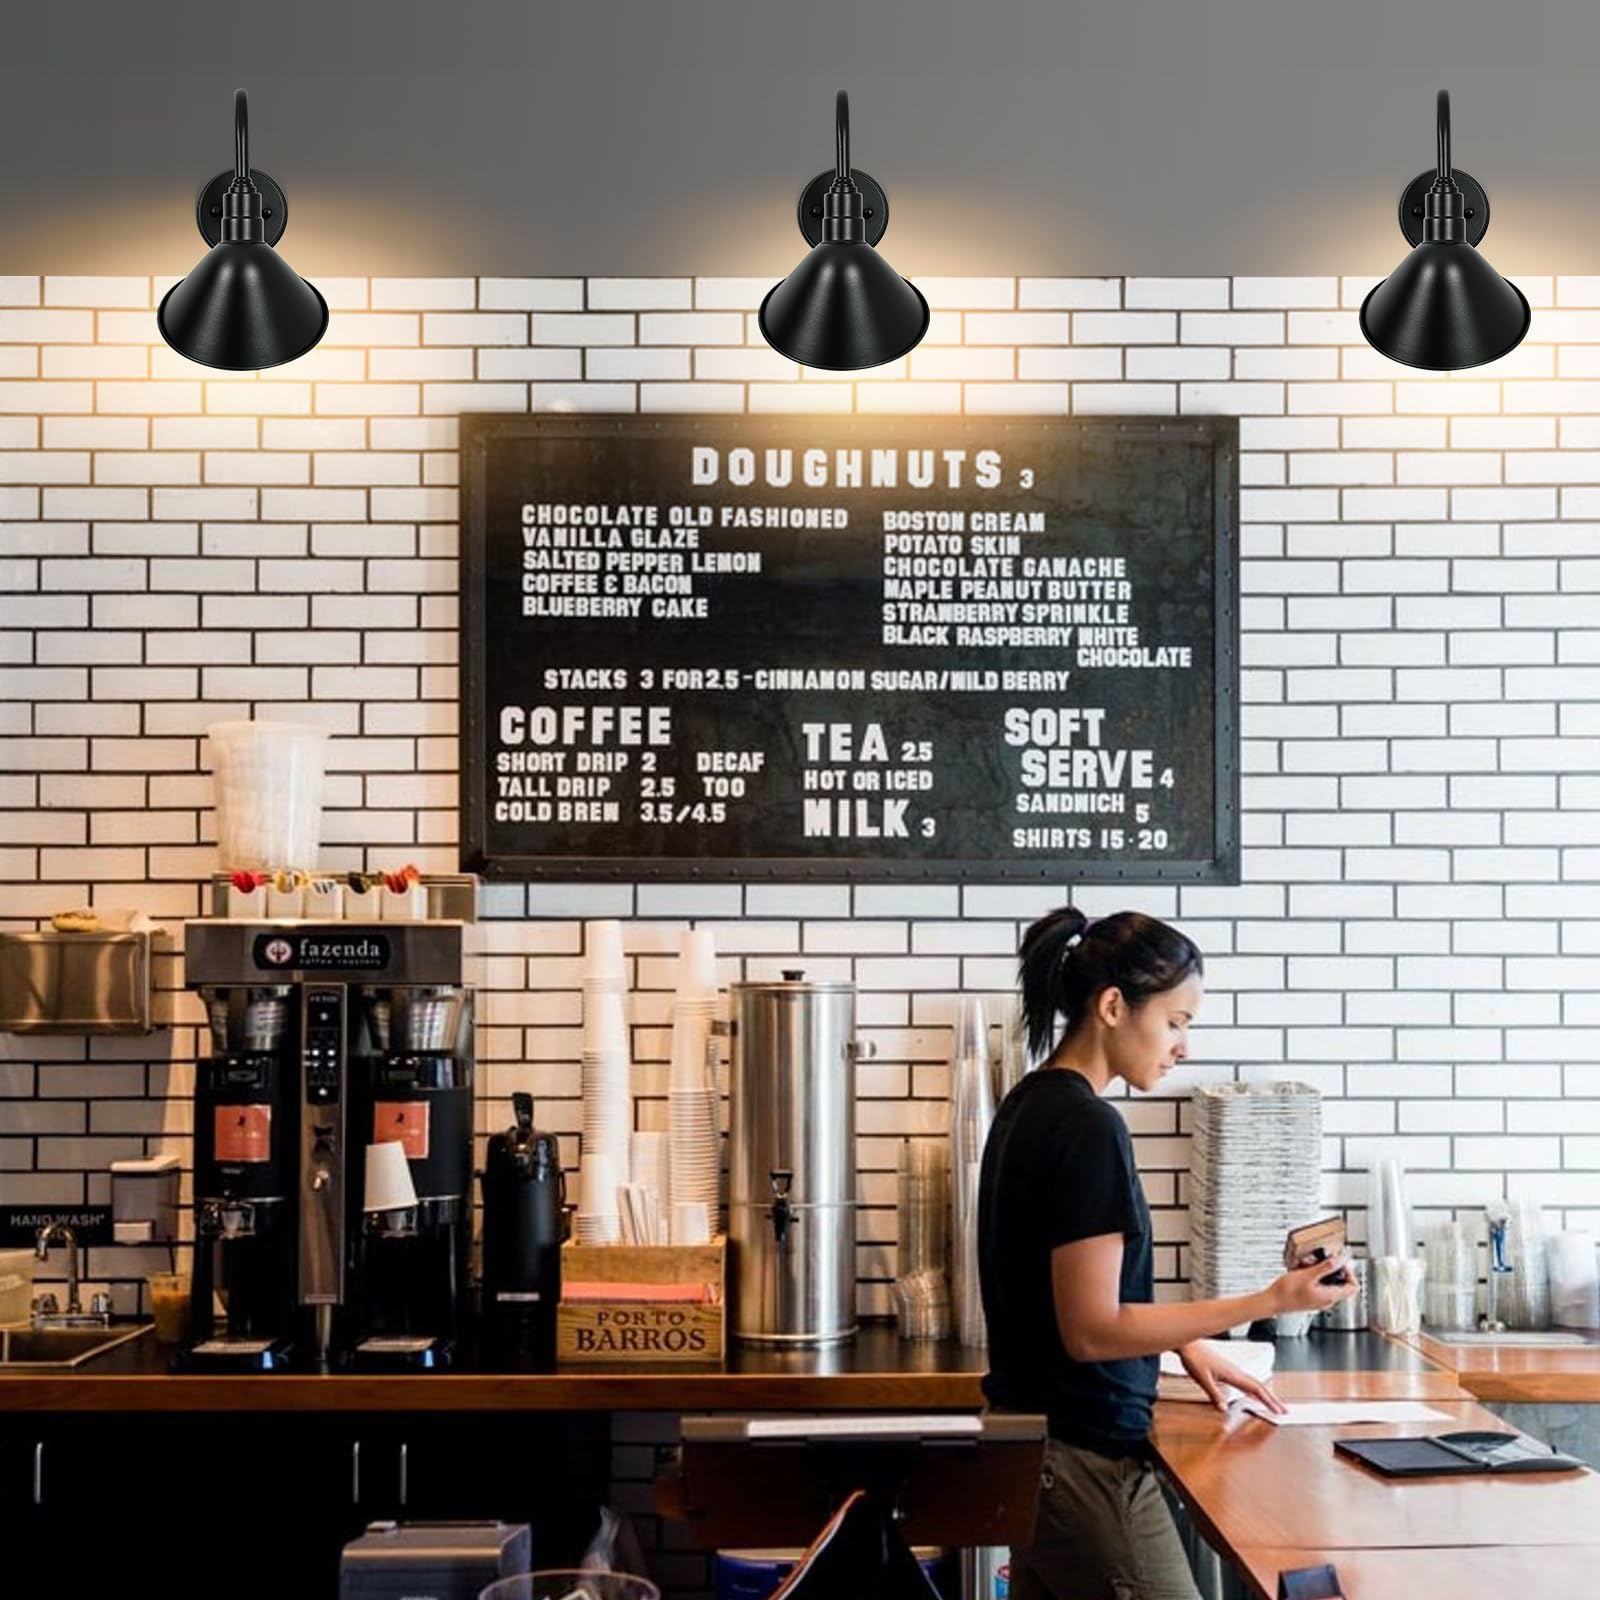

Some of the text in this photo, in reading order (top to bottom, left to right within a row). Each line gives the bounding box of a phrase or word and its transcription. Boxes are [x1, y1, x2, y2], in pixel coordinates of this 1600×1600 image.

[692, 446, 1034, 489] DOUGHNUTS 3
[522, 504, 848, 529] CHOCOLATE OLD FASHIONED
[883, 510, 1045, 533] BOSTON CREAM
[522, 527, 699, 549] VANILLA GLAZE
[885, 534, 1020, 556] POTATO SKIN
[524, 549, 761, 573] SALTED PEPPER LEMON
[884, 556, 1126, 578] CHOCOLATE GANACHE
[523, 573, 598, 594] COFFEE
[623, 574, 692, 595] BACON
[884, 579, 1132, 601] MAPLE PEANUT BUTTER
[523, 596, 708, 618] BLUEBERRY CAKE
[883, 602, 1129, 624] STRAWBERRY SPRINKLE
[883, 624, 1138, 647] BLACK RASPBERRY WHITE
[1077, 646, 1192, 668] CHOCOLATE
[545, 669, 627, 689] STACKS
[640, 669, 654, 689] 3
[705, 669, 739, 690] 2.5
[1002, 670, 1070, 691] BERRY
[500, 706, 670, 745] COFFEE
[1004, 708, 1105, 747] SOFT
[802, 723, 889, 762] TEA
[497, 752, 656, 772] SHORT DRIP 2
[697, 751, 764, 772] DECAF
[1020, 749, 1175, 789] SERVE 4
[498, 776, 675, 797] TALL DRIP 2.5
[703, 776, 745, 797] TOO
[804, 769, 933, 791] HOT OR ICED
[495, 801, 552, 821] COLD
[558, 801, 619, 822] BREW
[804, 798, 936, 838] MILK 3
[1016, 792, 1150, 824] SANDWICH 5
[1012, 828, 1092, 849] SHIRTS
[300, 938, 380, 957] fazenda
[10, 1213, 101, 1227] HAND WASH
[597, 1311, 685, 1326] PORTO
[576, 1328, 706, 1352] BARROS
